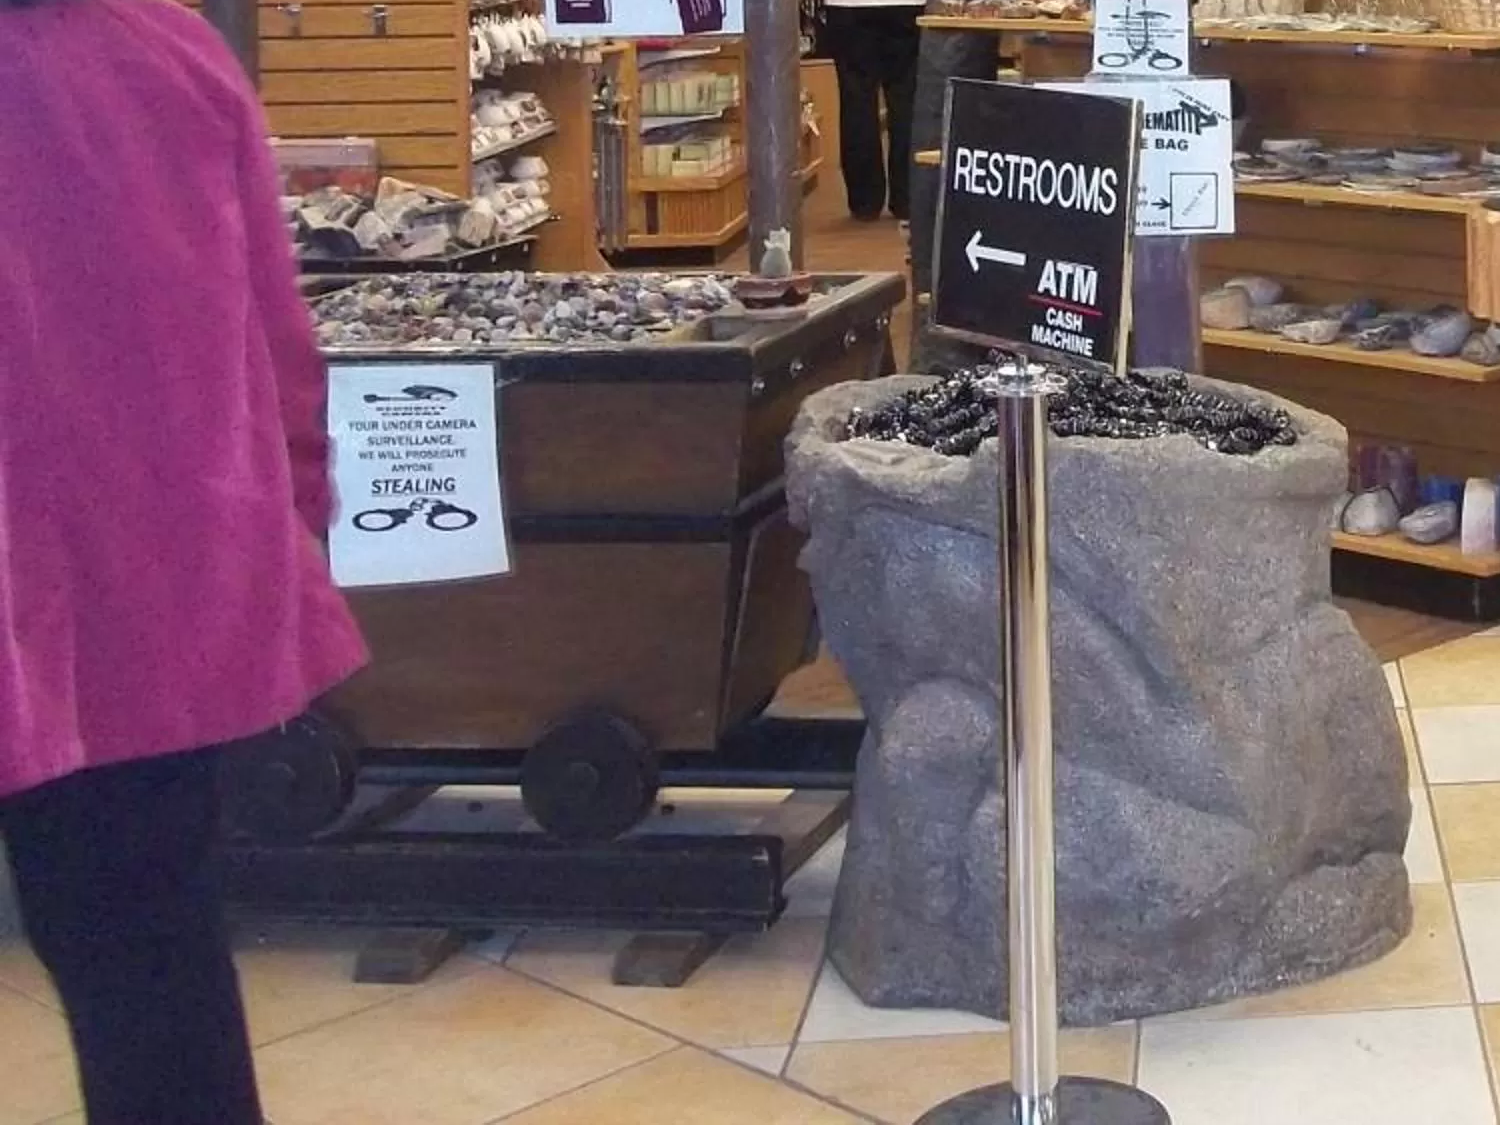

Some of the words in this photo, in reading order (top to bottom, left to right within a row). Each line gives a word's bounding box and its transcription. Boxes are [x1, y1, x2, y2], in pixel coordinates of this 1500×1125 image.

[1143, 101, 1203, 136] EMATITE
[1154, 138, 1190, 152] BAG
[953, 146, 1118, 216] RESTROOMS
[1037, 259, 1098, 306] ATM
[1045, 306, 1083, 332] CASH
[1031, 324, 1095, 357] MACHINE
[348, 420, 379, 431] YOUR
[382, 420, 423, 431] UNDER
[426, 418, 477, 430] CAMERA
[358, 450, 374, 460] WE
[378, 450, 402, 460] WILL
[405, 448, 466, 459] PROSECUTE
[391, 463, 433, 472] ANYONE
[371, 477, 457, 494] STEALING
